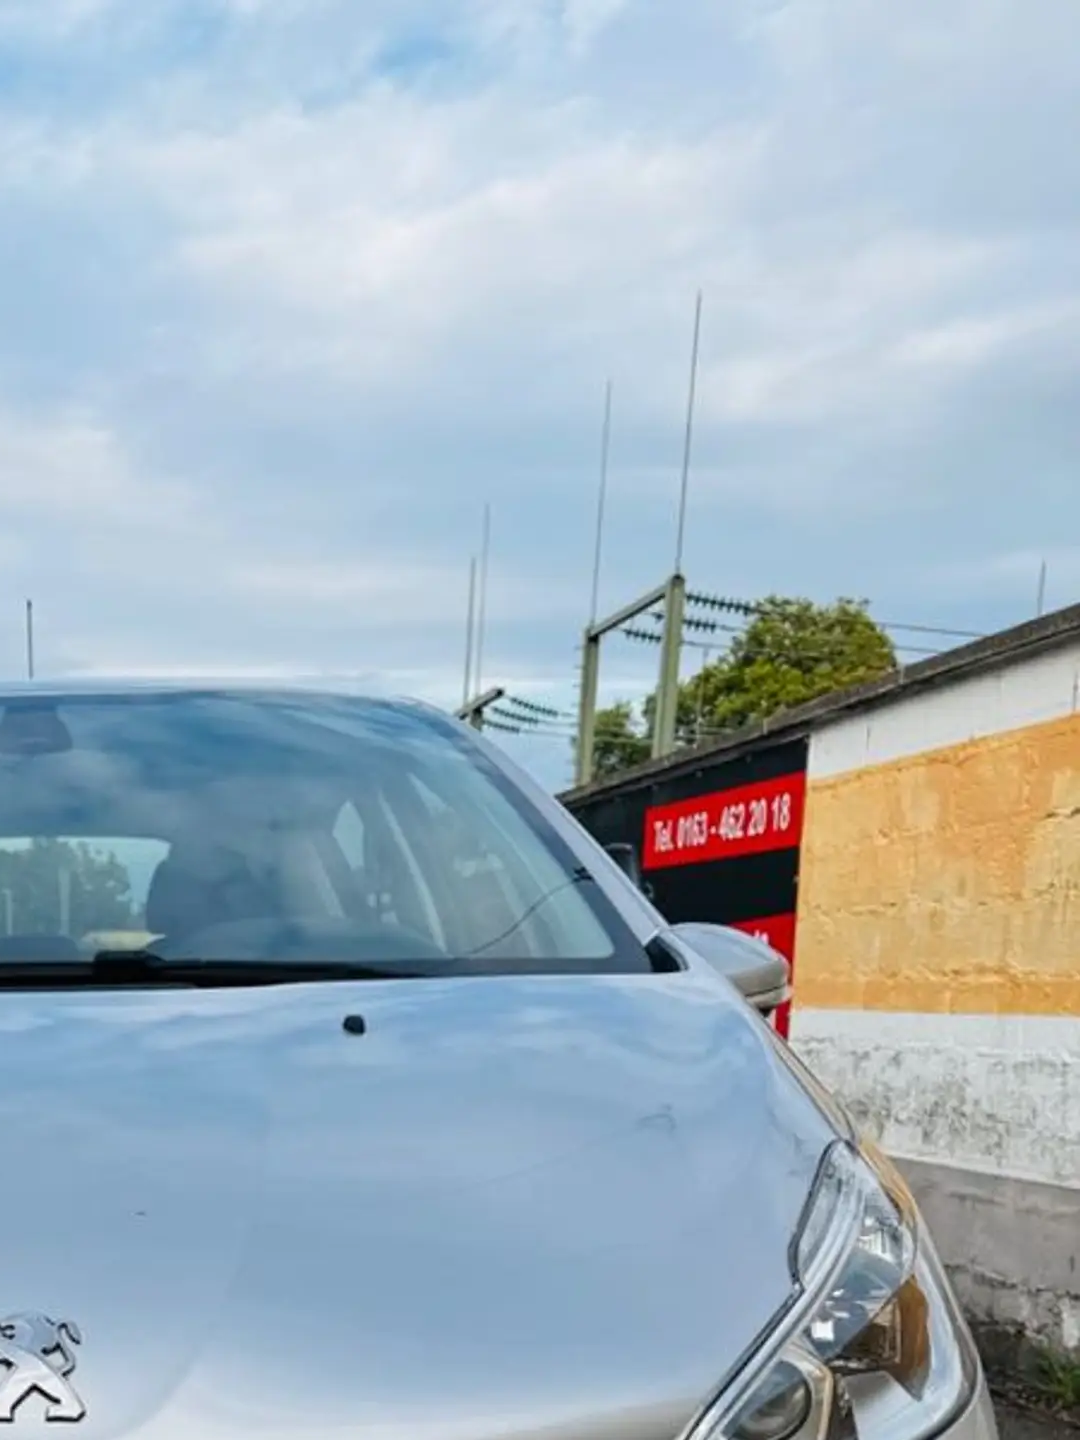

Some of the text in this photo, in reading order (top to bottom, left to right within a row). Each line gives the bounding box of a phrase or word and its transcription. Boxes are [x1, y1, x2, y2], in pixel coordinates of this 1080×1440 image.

[653, 819, 674, 852] Tel.
[677, 811, 708, 848] 0163
[718, 802, 745, 841] 462
[747, 797, 767, 836] 20
[771, 792, 791, 832] 18
